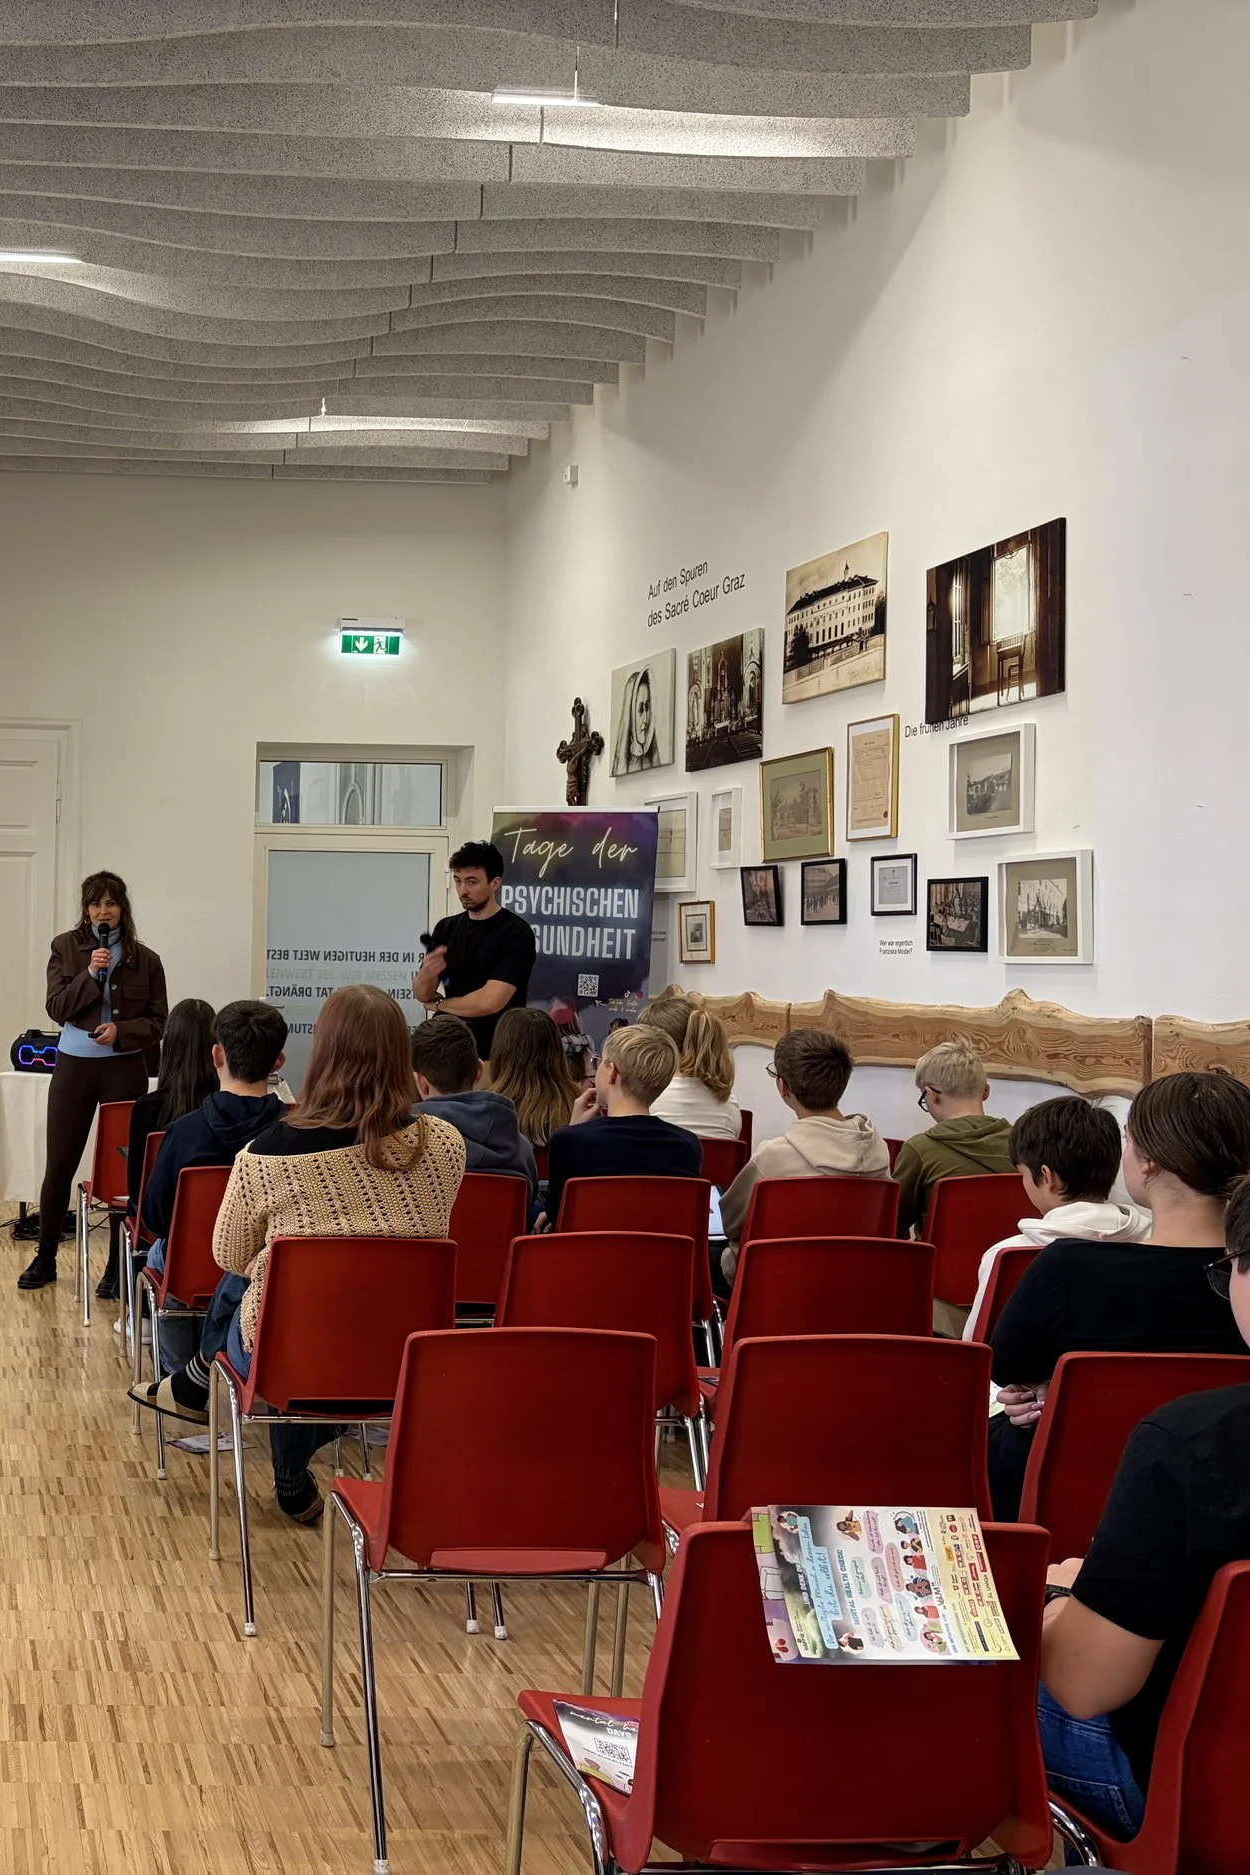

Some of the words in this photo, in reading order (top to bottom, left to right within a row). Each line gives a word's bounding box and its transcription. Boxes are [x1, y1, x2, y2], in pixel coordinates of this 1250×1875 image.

[648, 580, 661, 600] Auf
[663, 576, 677, 592] den
[680, 561, 708, 586] Spuren
[648, 610, 662, 627] des
[665, 594, 689, 620] Sacré
[692, 584, 719, 608] Coeur
[722, 573, 745, 594] Graz
[904, 725, 918, 738] Die
[504, 827, 574, 878] Tage
[592, 826, 638, 868] der
[500, 885, 639, 918] PSYCHISCHEN
[530, 924, 637, 960] SUNDHEIT
